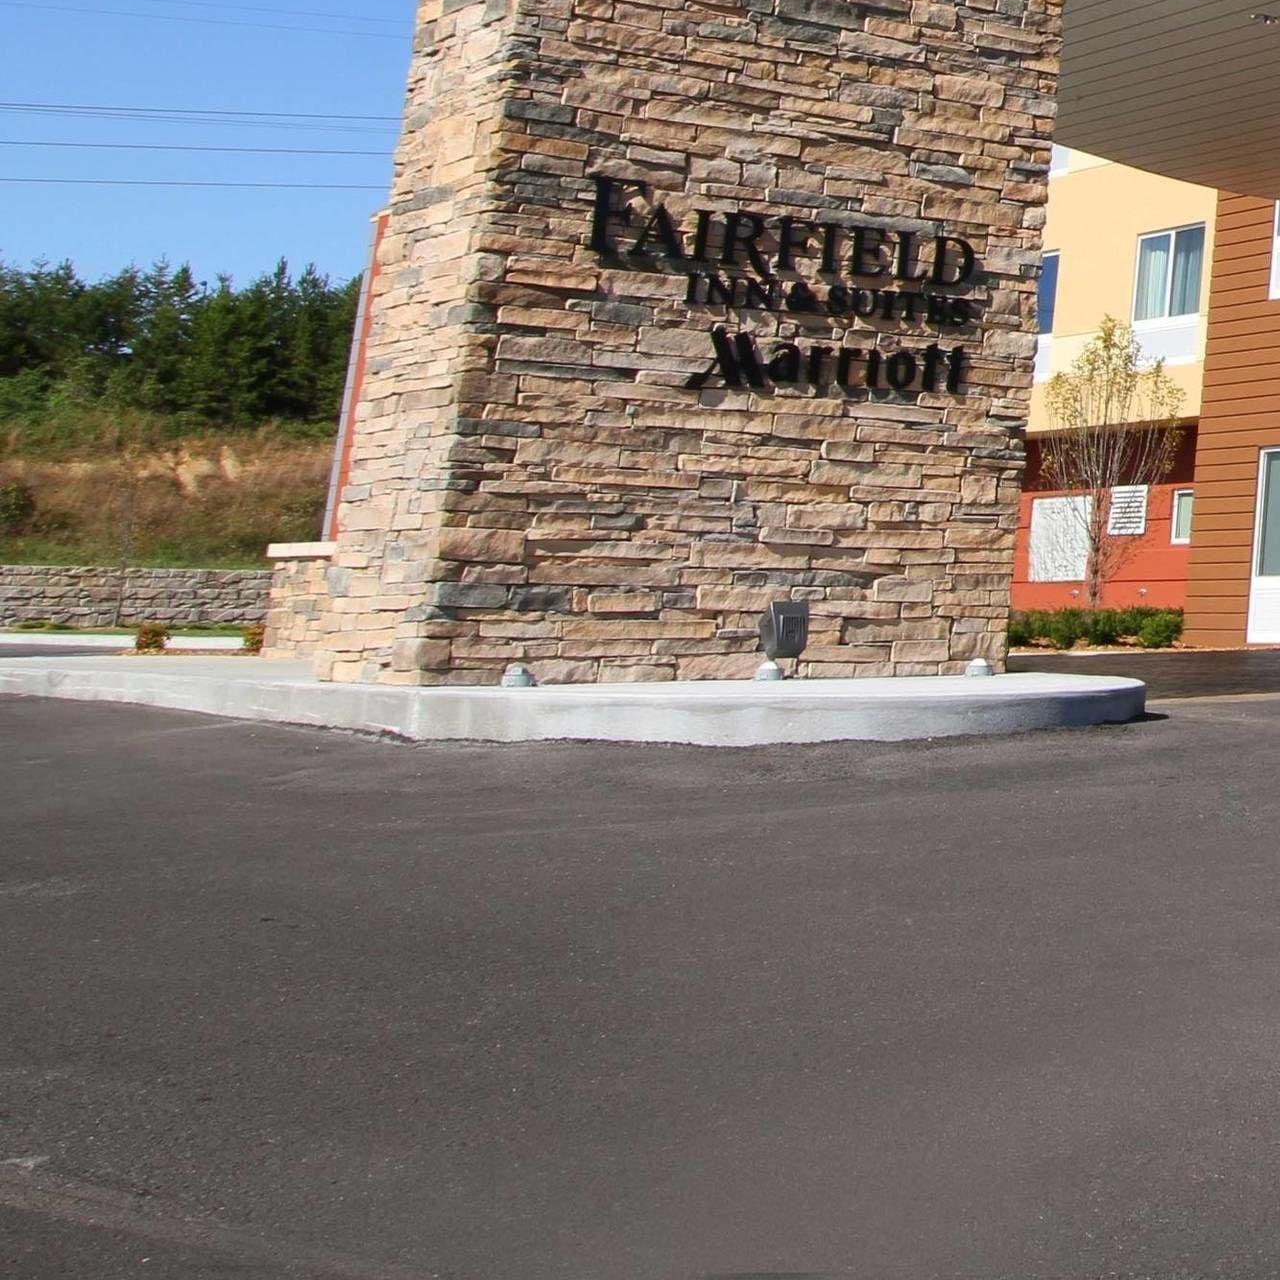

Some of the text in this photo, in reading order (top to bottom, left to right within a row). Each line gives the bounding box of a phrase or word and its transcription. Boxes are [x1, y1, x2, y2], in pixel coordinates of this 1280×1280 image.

[589, 176, 976, 286] FAIRFIELD
[684, 272, 977, 326] INN & SUITES
[686, 326, 966, 395] Marriott
